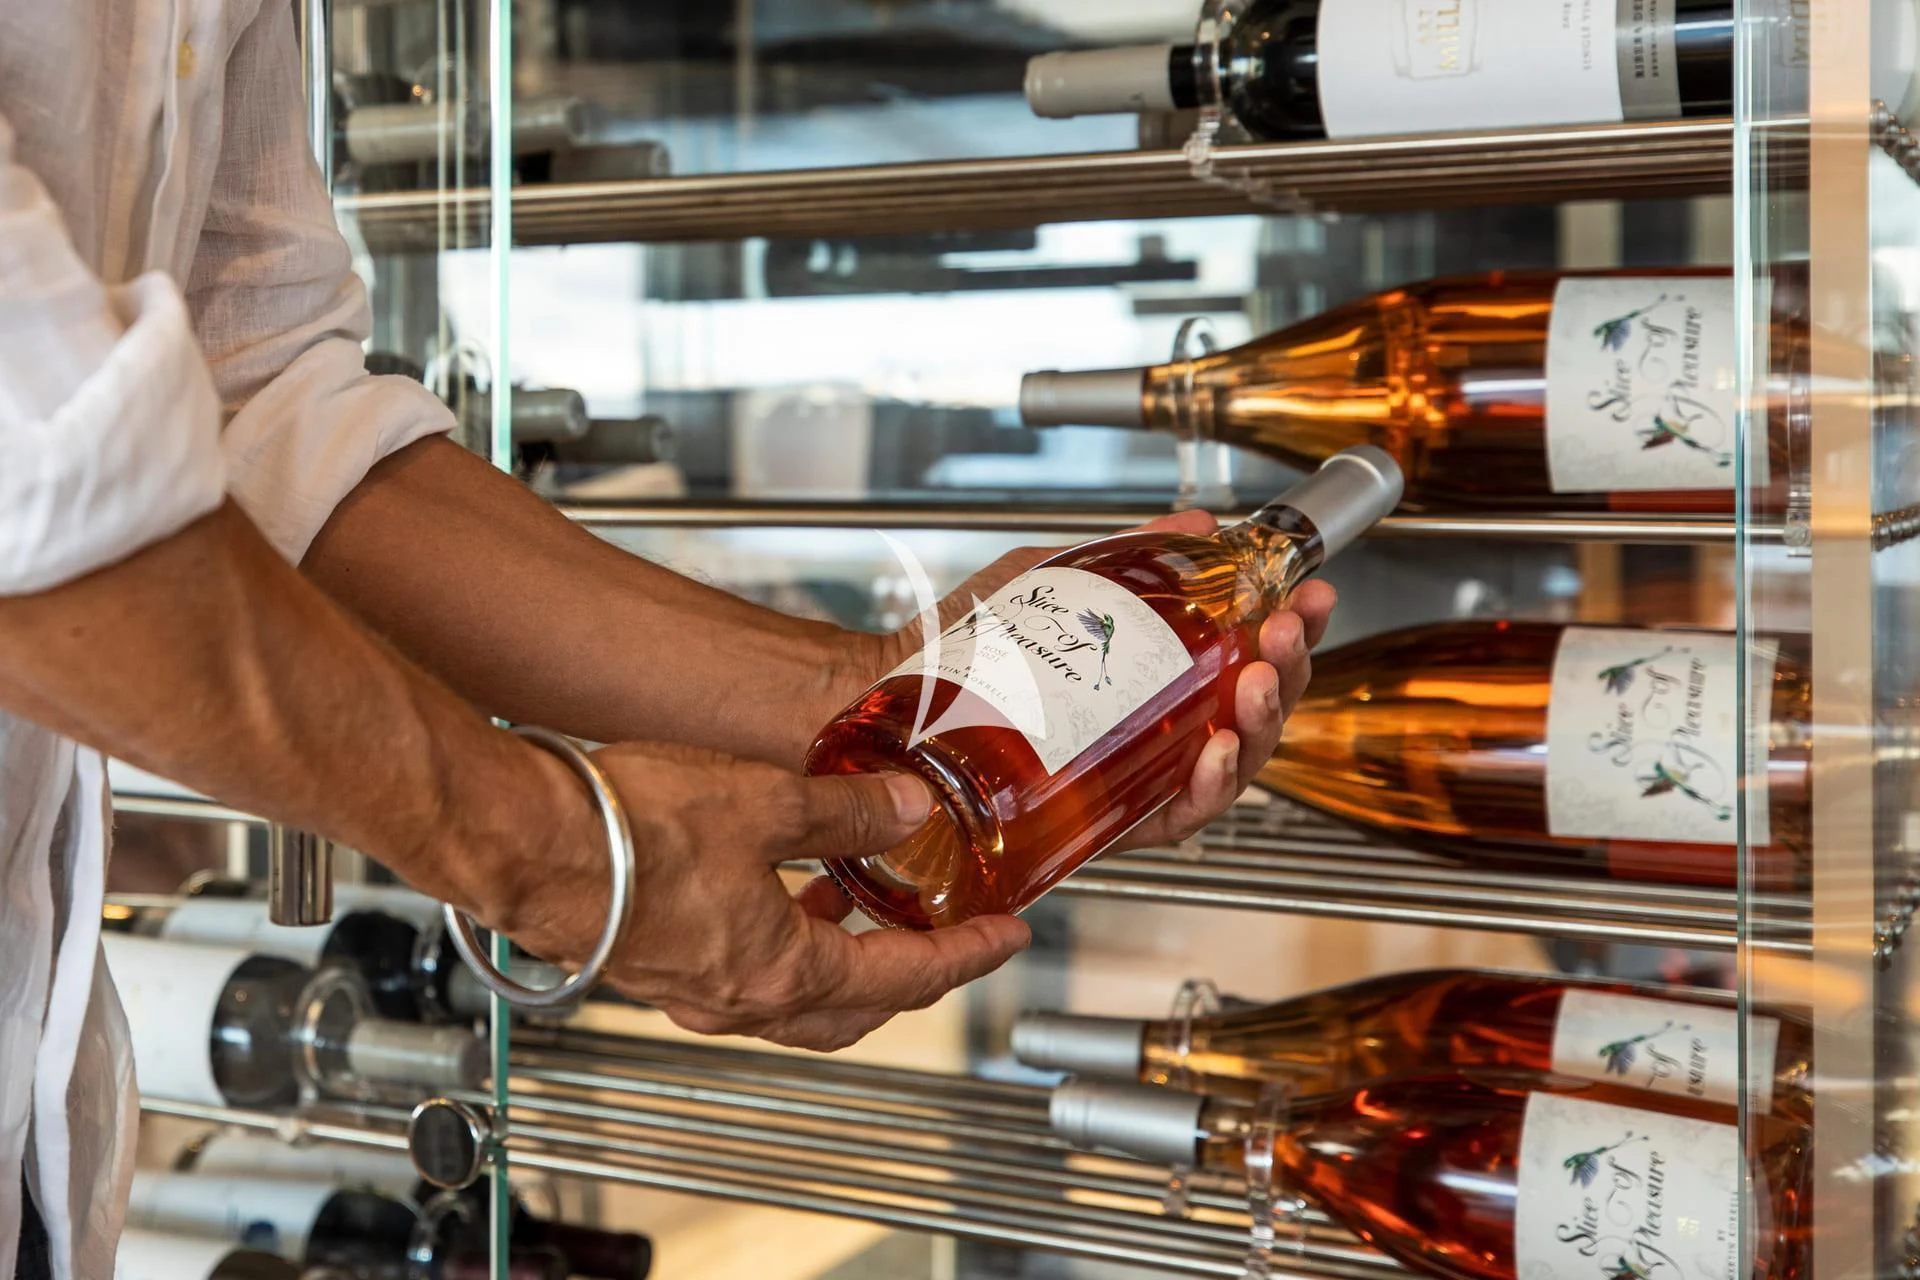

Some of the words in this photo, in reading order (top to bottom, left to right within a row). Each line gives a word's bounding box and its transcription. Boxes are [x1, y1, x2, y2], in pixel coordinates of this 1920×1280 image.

[1435, 0, 1461, 73] MILL
[1632, 26, 1646, 79] RIBERA
[1587, 359, 1632, 424] Slice
[1669, 307, 1704, 422] Pleasure
[1010, 585, 1069, 615] Slice
[964, 619, 1082, 683] Pleasure
[1588, 703, 1634, 768] Slice
[1670, 657, 1707, 770] Pleasure
[1555, 1196, 1599, 1257] Slice
[1630, 1151, 1668, 1267] Pleasure
